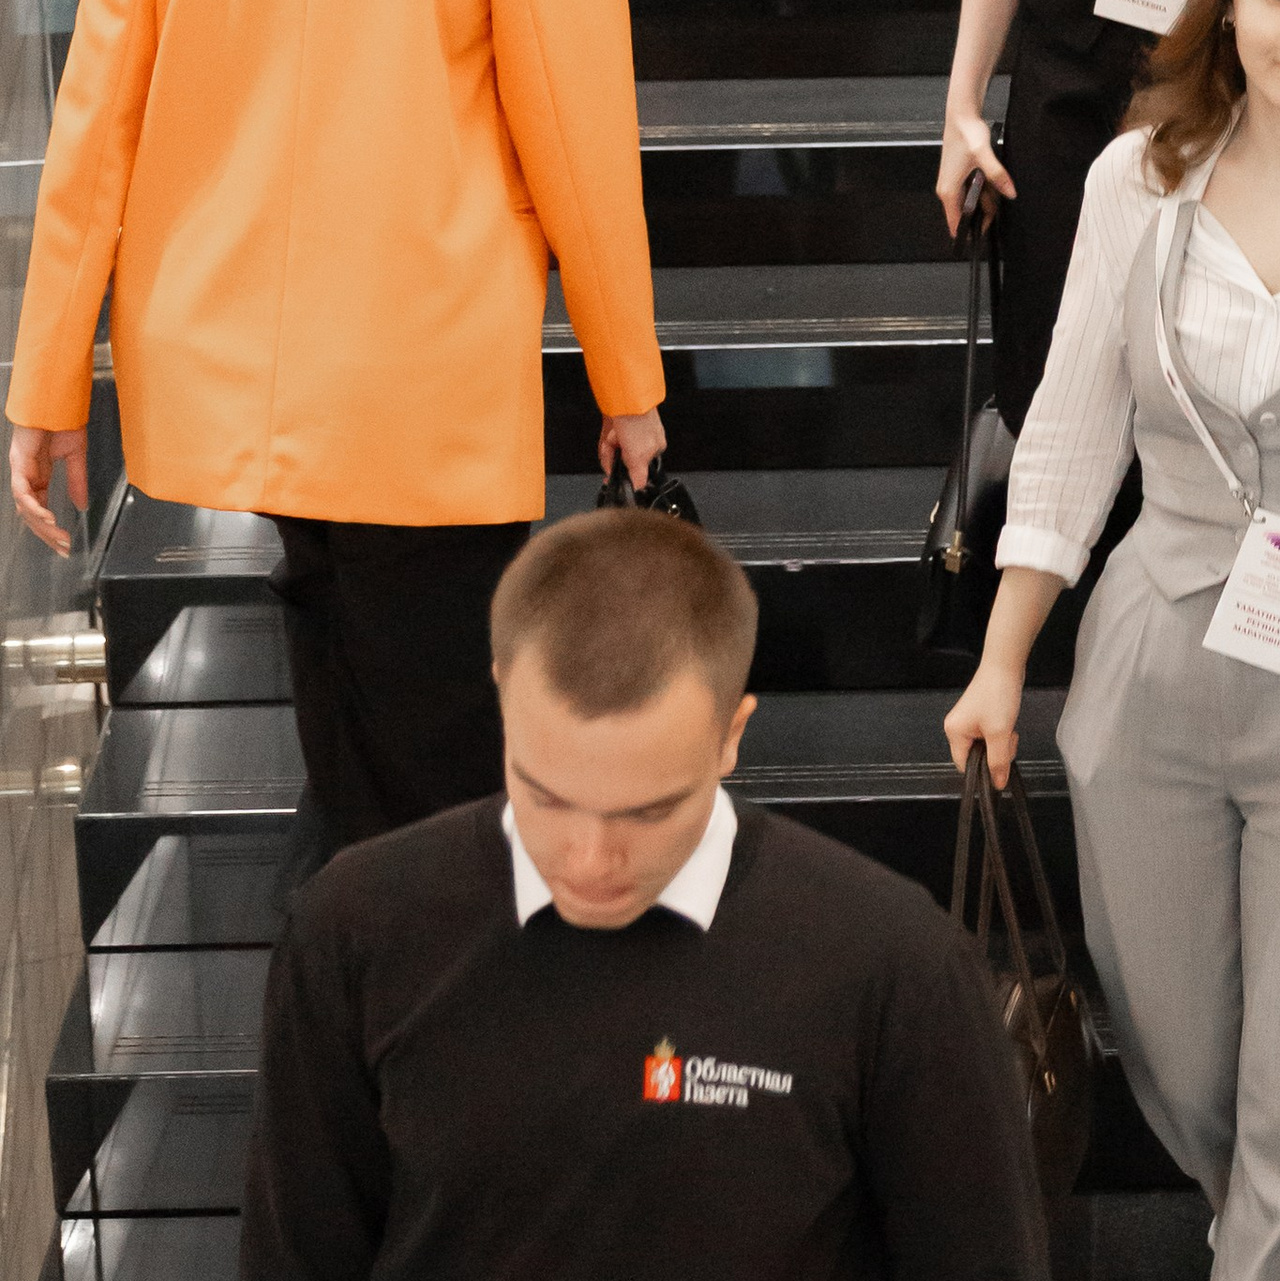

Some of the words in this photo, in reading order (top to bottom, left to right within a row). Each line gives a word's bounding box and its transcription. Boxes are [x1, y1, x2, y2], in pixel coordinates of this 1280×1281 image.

[1246, 617, 1280, 636] РЕГИНА
[684, 1055, 794, 1094] Областная
[684, 1078, 750, 1108] Газета
